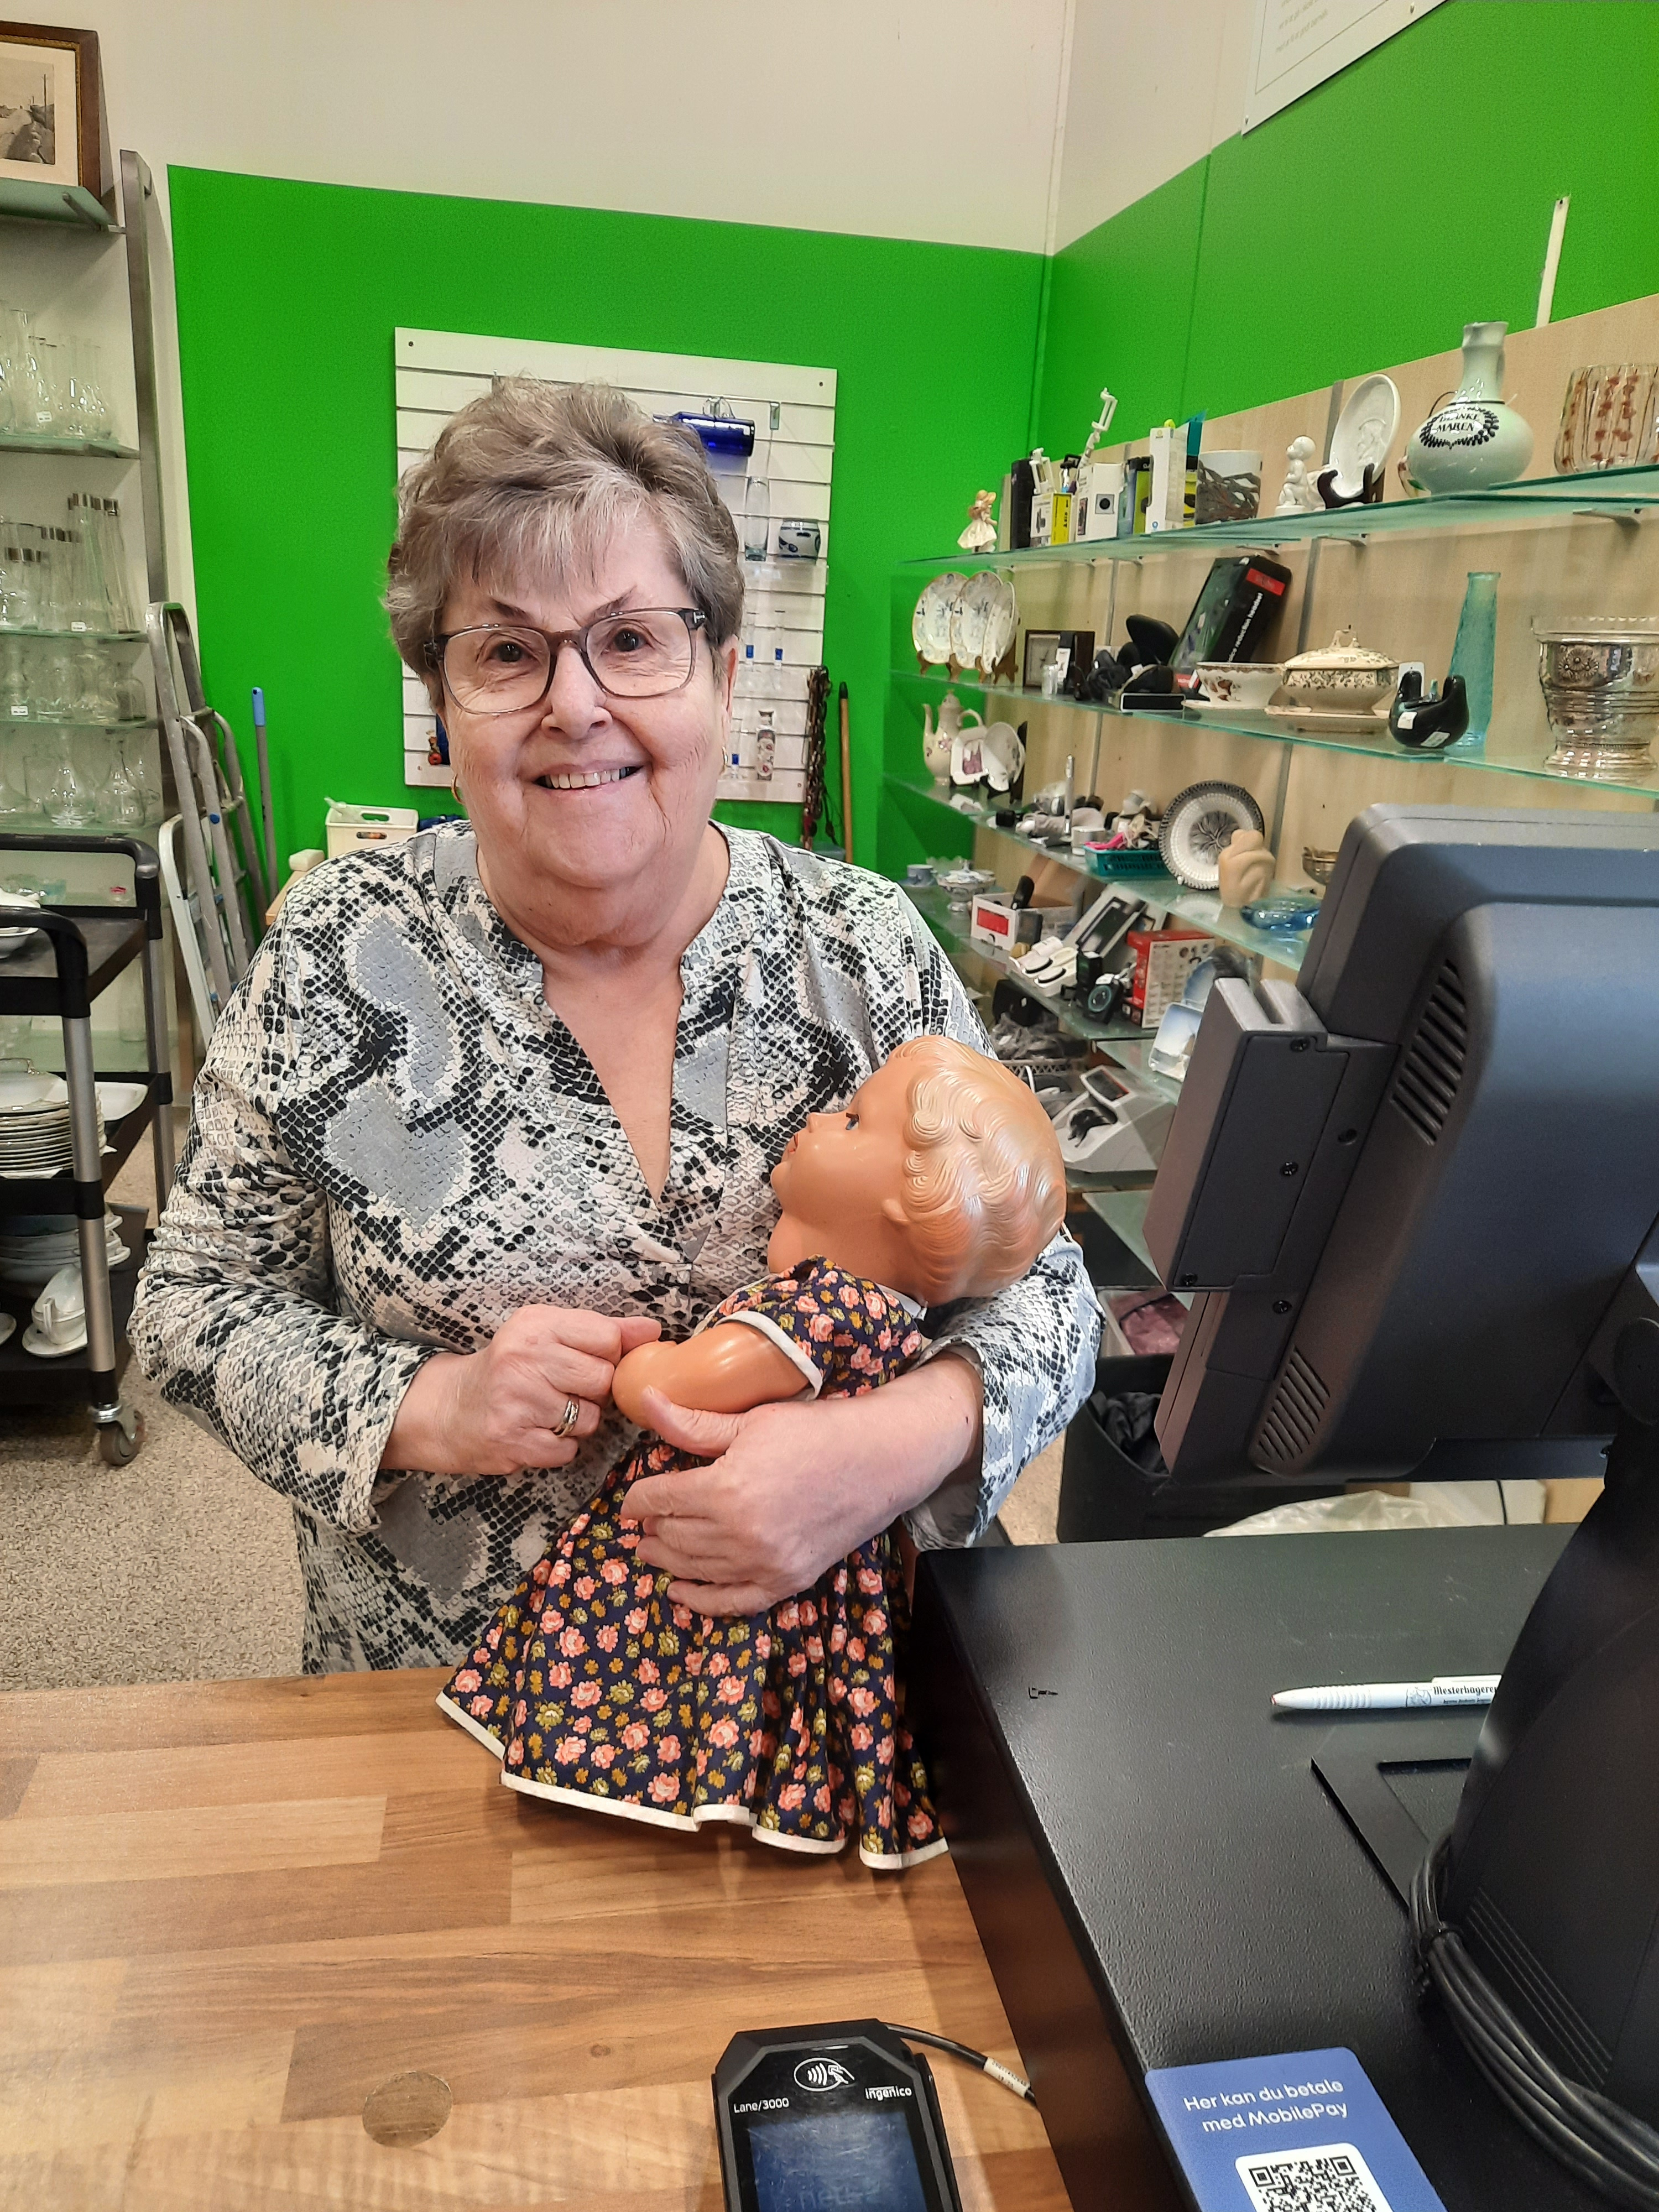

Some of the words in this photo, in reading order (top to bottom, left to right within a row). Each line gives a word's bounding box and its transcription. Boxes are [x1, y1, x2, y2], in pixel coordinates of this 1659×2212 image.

[1247, 592, 1264, 618] headset
[734, 2098, 789, 2113] Lane/3000
[1183, 2095, 1217, 2111] Her
[1219, 2093, 1257, 2106] kan
[1259, 2086, 1285, 2101] du
[1283, 2079, 1344, 2098] betale
[1202, 2113, 1246, 2132] med
[1248, 2102, 1348, 2126] MobilePay
